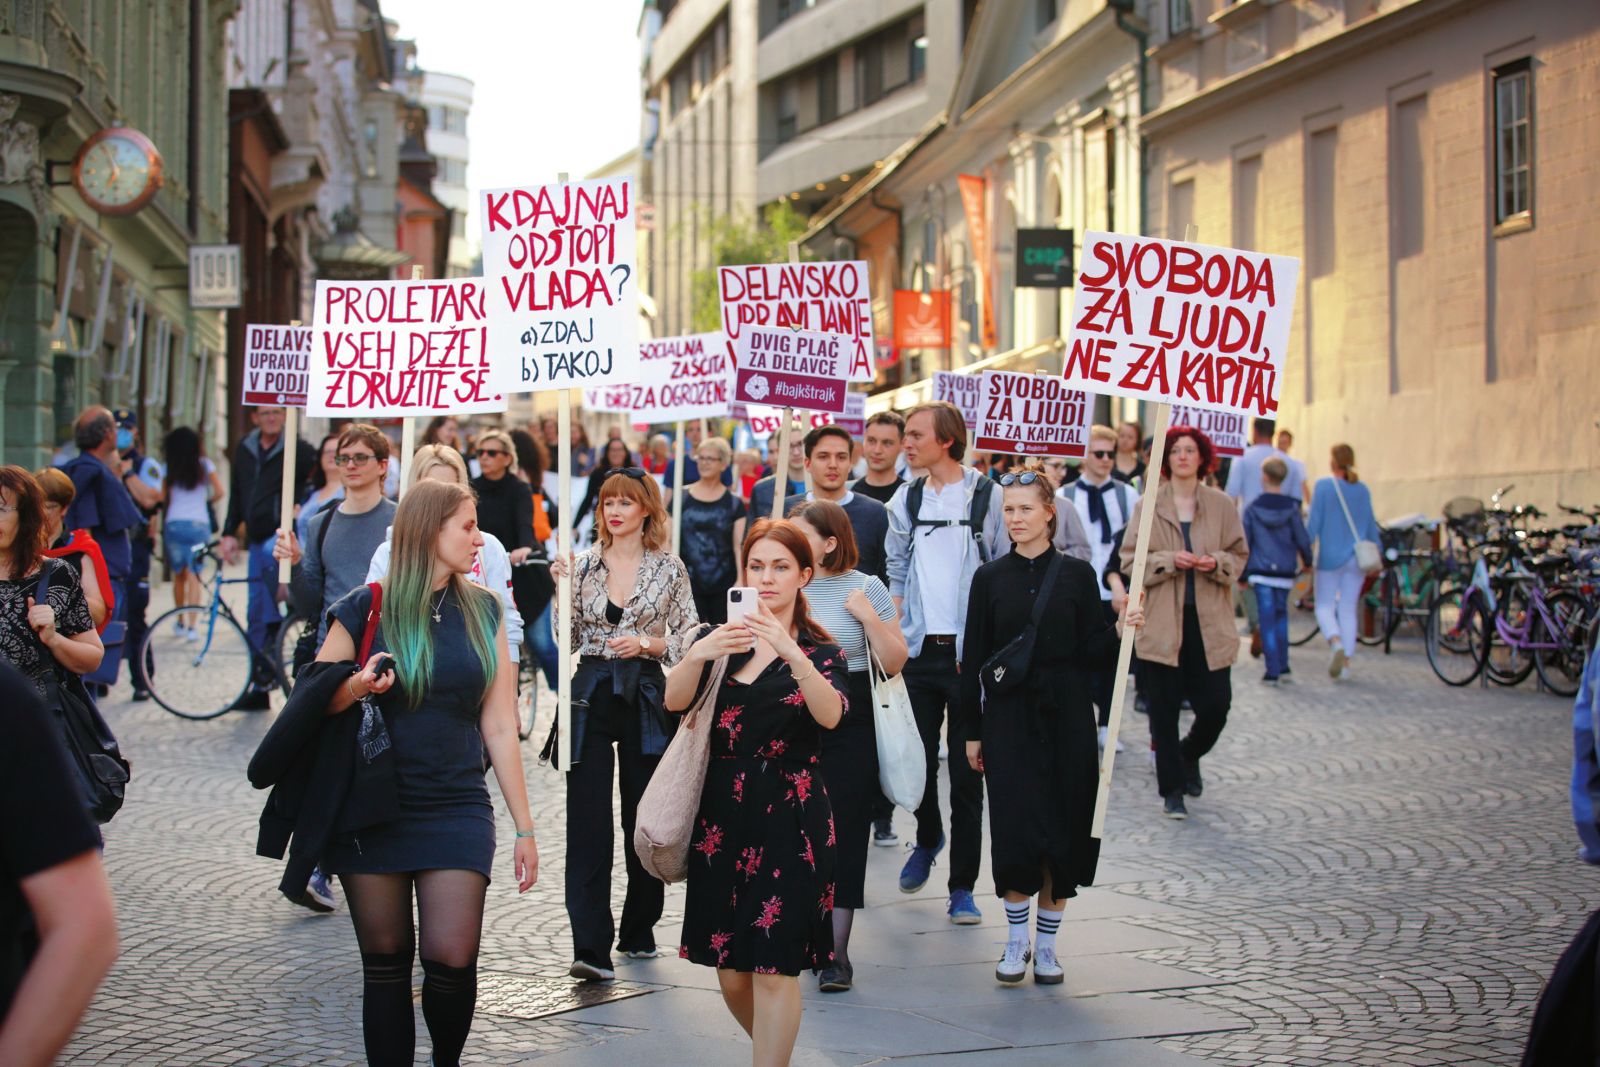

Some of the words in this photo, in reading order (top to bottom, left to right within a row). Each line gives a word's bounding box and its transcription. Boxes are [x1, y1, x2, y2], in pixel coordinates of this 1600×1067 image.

[508, 222, 615, 269] ODSTOPI
[194, 253, 236, 289] 1991
[501, 263, 631, 312] VLADA?
[721, 263, 859, 302] DELAVSKO
[1079, 241, 1276, 307] SVOBODA
[1076, 286, 1134, 336] ZA
[1149, 296, 1270, 363] LJUDI,
[250, 352, 310, 371] UPRAVLJ
[323, 331, 396, 370] VSEH
[751, 332, 791, 353] DVIG
[796, 335, 839, 359] PLAČ
[543, 348, 613, 381] TAKOJ
[749, 351, 766, 368] ZA
[772, 354, 837, 376] DELAVCE
[1063, 338, 1118, 383] NE
[1117, 342, 1170, 395] ZA
[1175, 350, 1279, 416] KAPITAL
[249, 371, 260, 391] V
[775, 381, 836, 403] #bajkštrajk
[632, 386, 656, 410] ZA
[985, 396, 1013, 422] ZA
[983, 422, 1001, 438] NE
[1004, 424, 1022, 440] ZA
[1027, 426, 1082, 444] KAPITAL
